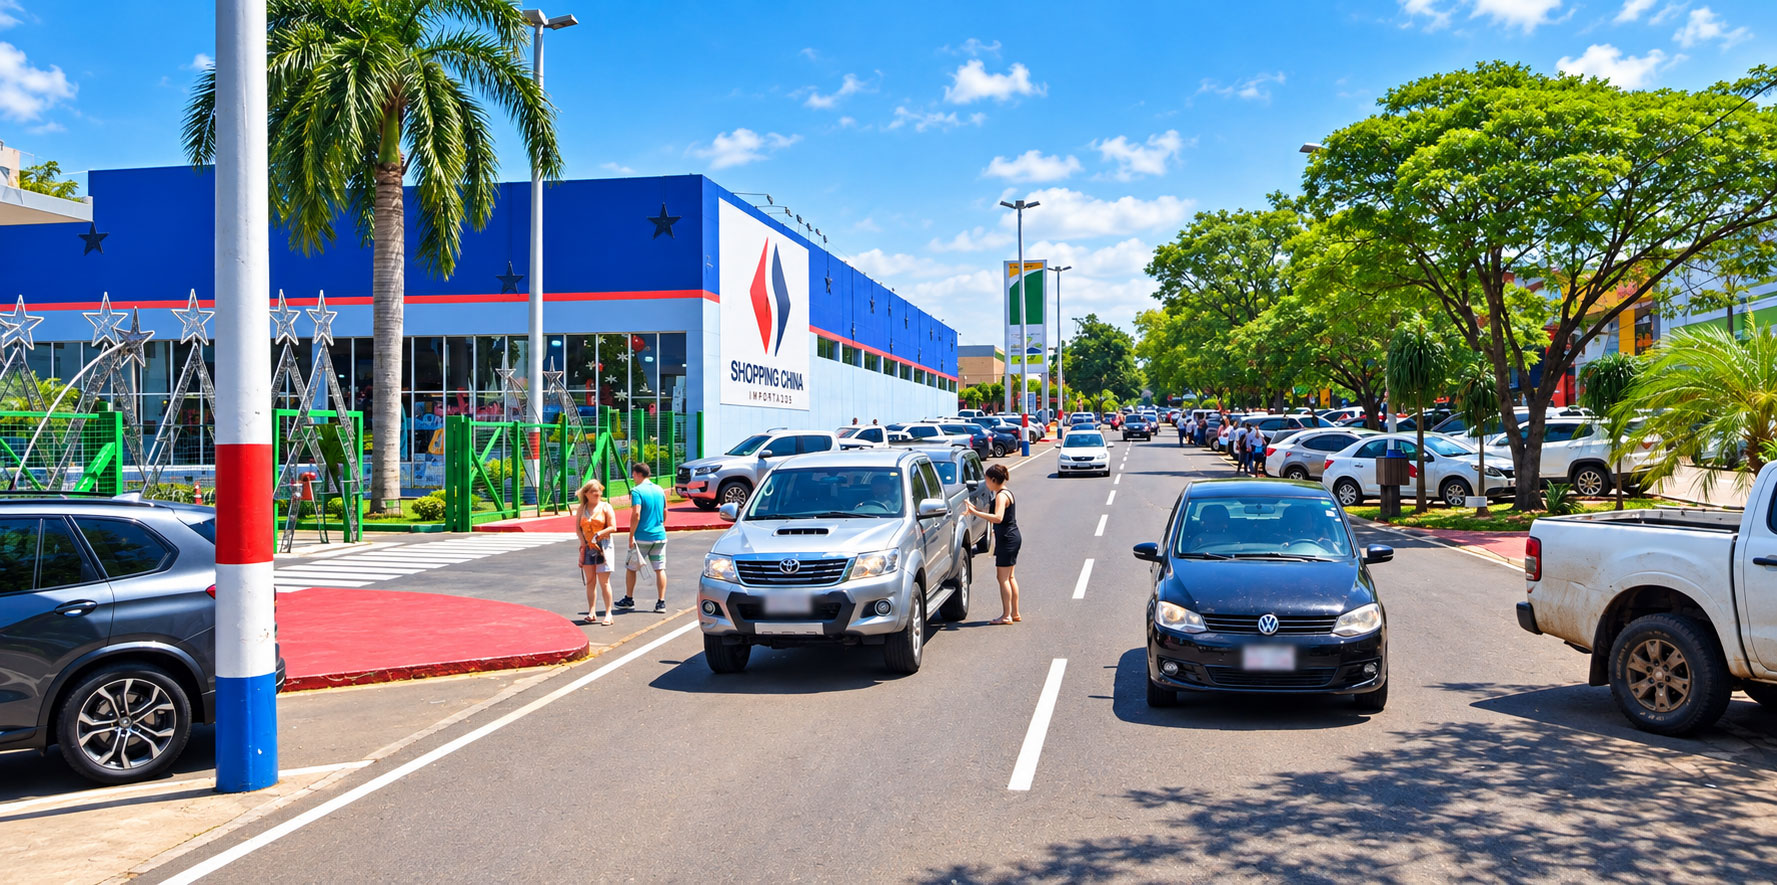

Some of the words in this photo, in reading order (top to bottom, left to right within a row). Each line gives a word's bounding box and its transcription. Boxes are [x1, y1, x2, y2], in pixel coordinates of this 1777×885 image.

[731, 359, 779, 387] SHOPPING
[781, 369, 804, 391] CHINA
[1259, 614, 1279, 634] VW
